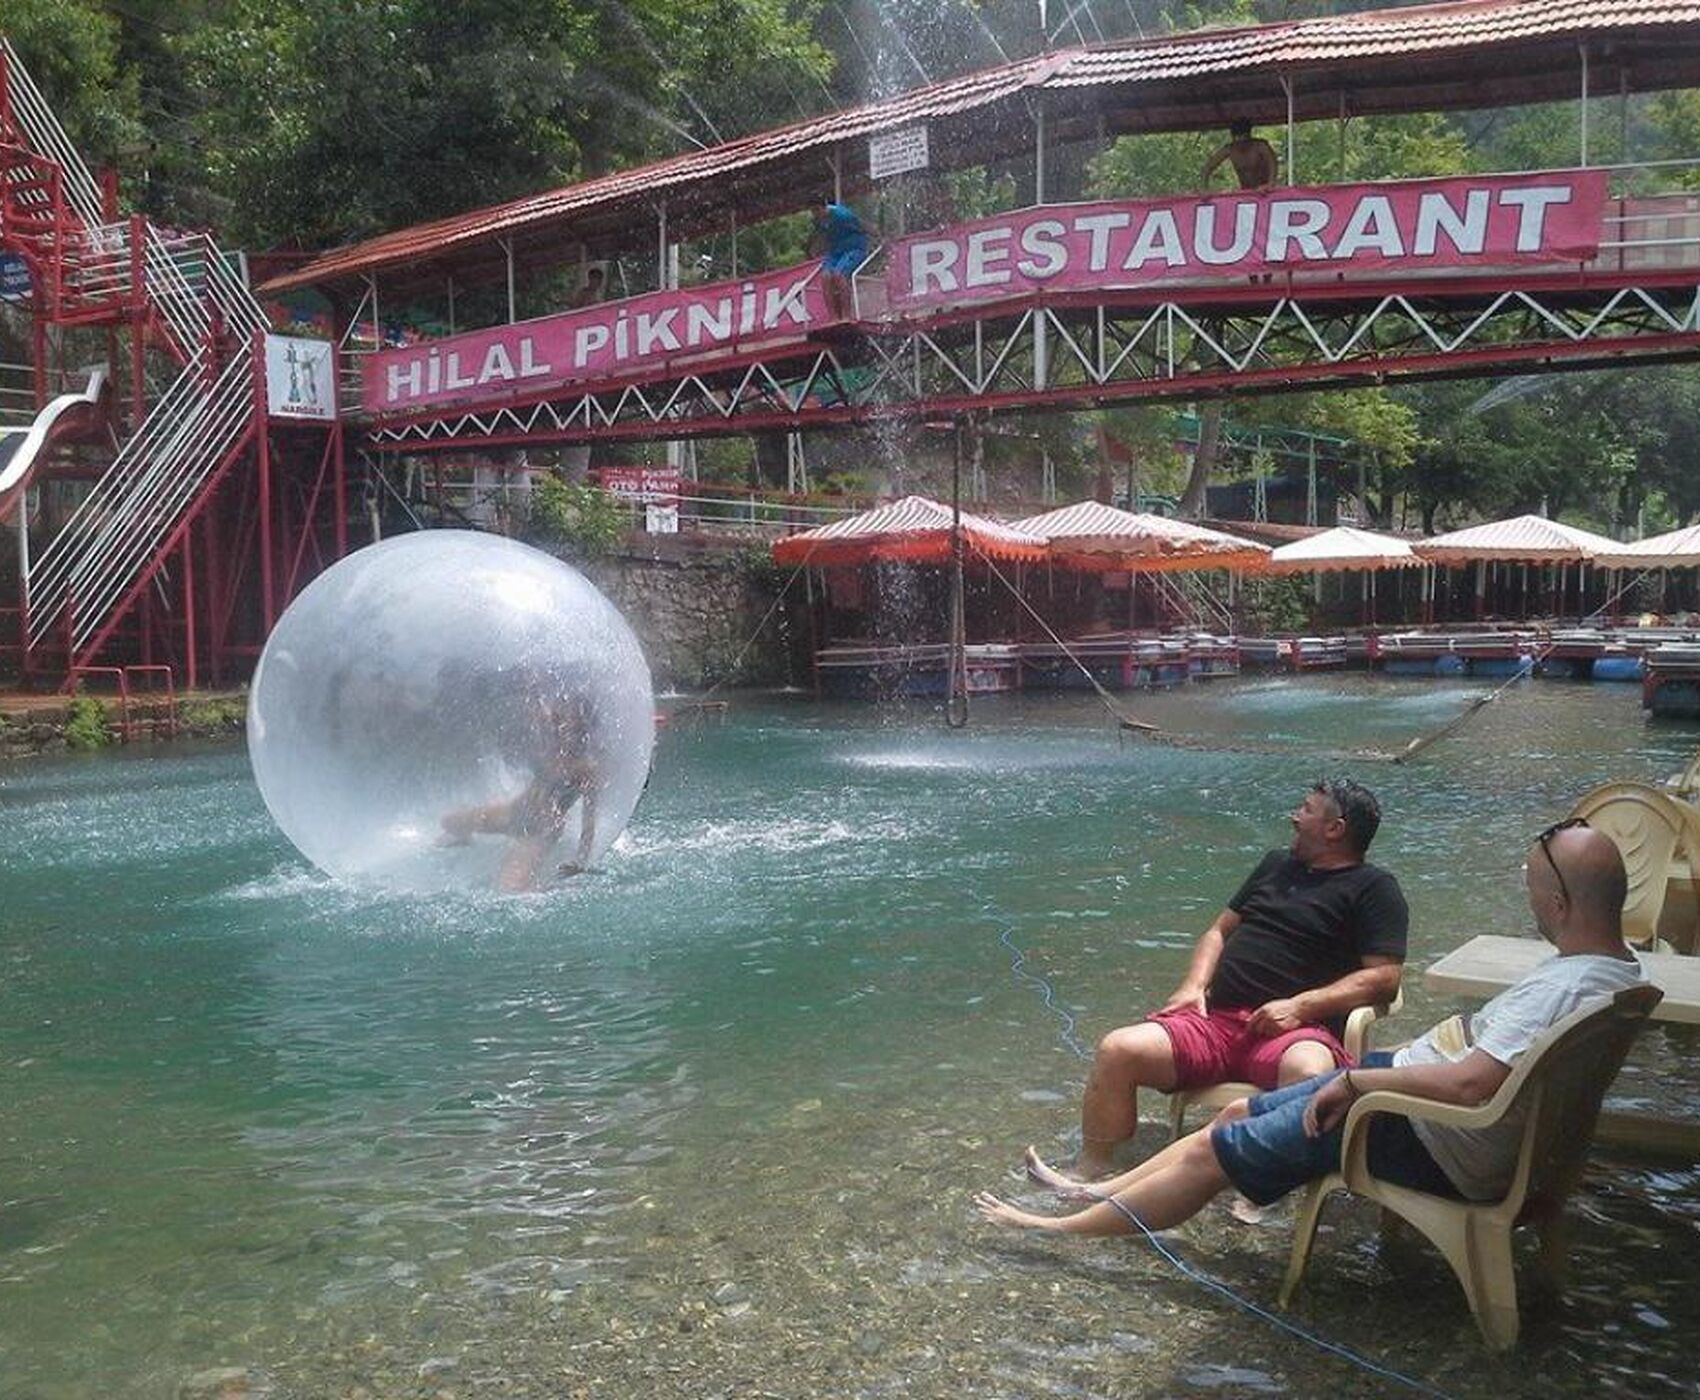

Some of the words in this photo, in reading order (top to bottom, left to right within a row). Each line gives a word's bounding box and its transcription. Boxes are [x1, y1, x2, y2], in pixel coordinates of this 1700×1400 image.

[909, 186, 1571, 295] RESTAURANT
[387, 338, 551, 402] HİLAL
[575, 283, 812, 369] PİKNİK
